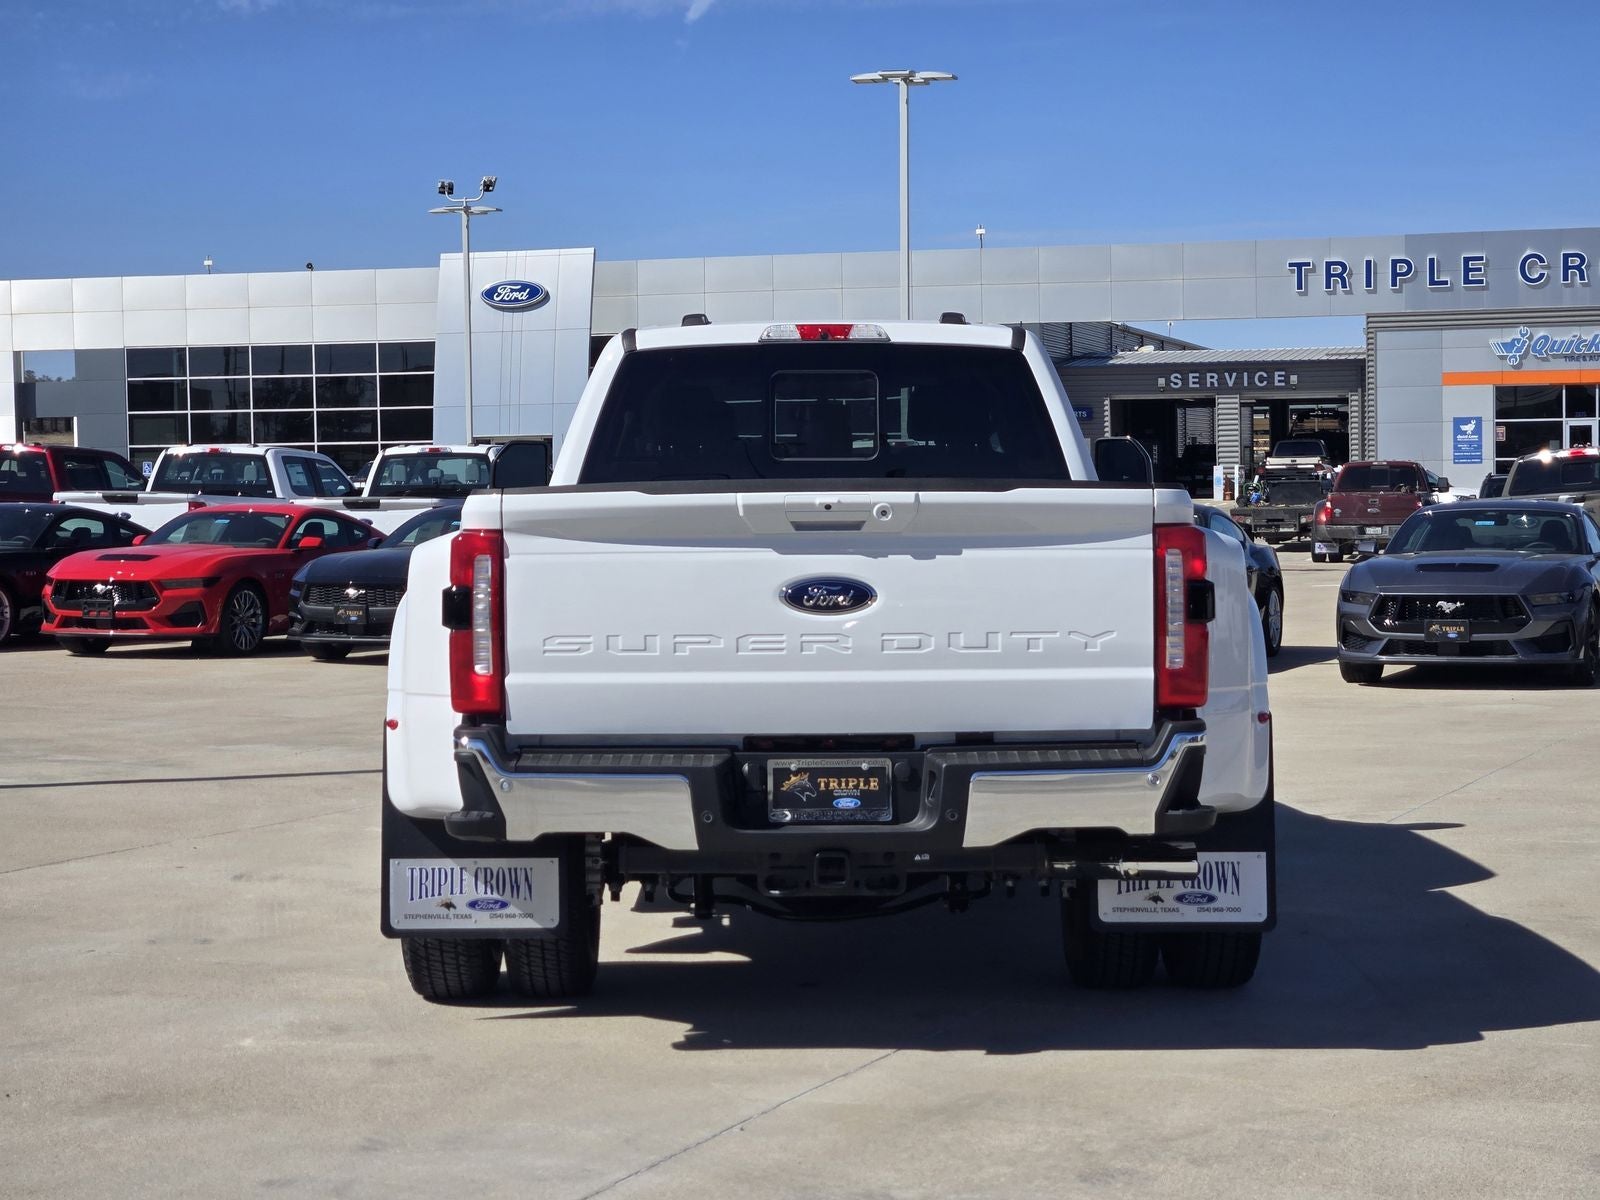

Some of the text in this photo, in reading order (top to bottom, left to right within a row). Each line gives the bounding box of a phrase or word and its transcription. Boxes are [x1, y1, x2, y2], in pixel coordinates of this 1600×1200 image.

[1287, 250, 1600, 292] TRIPLE CR
[493, 285, 530, 301] Ford
[1530, 333, 1600, 357] Quick
[1588, 354, 1600, 362] AU
[1169, 371, 1286, 389] SERVICE
[1073, 410, 1087, 418] RTS
[803, 585, 854, 606] Ford
[542, 630, 1117, 656] SUPER DUTY
[817, 777, 879, 791] TRIPLE
[407, 866, 533, 902] TRIPLE CROWN
[474, 900, 501, 910] Ford
[1182, 893, 1209, 904] Ford
